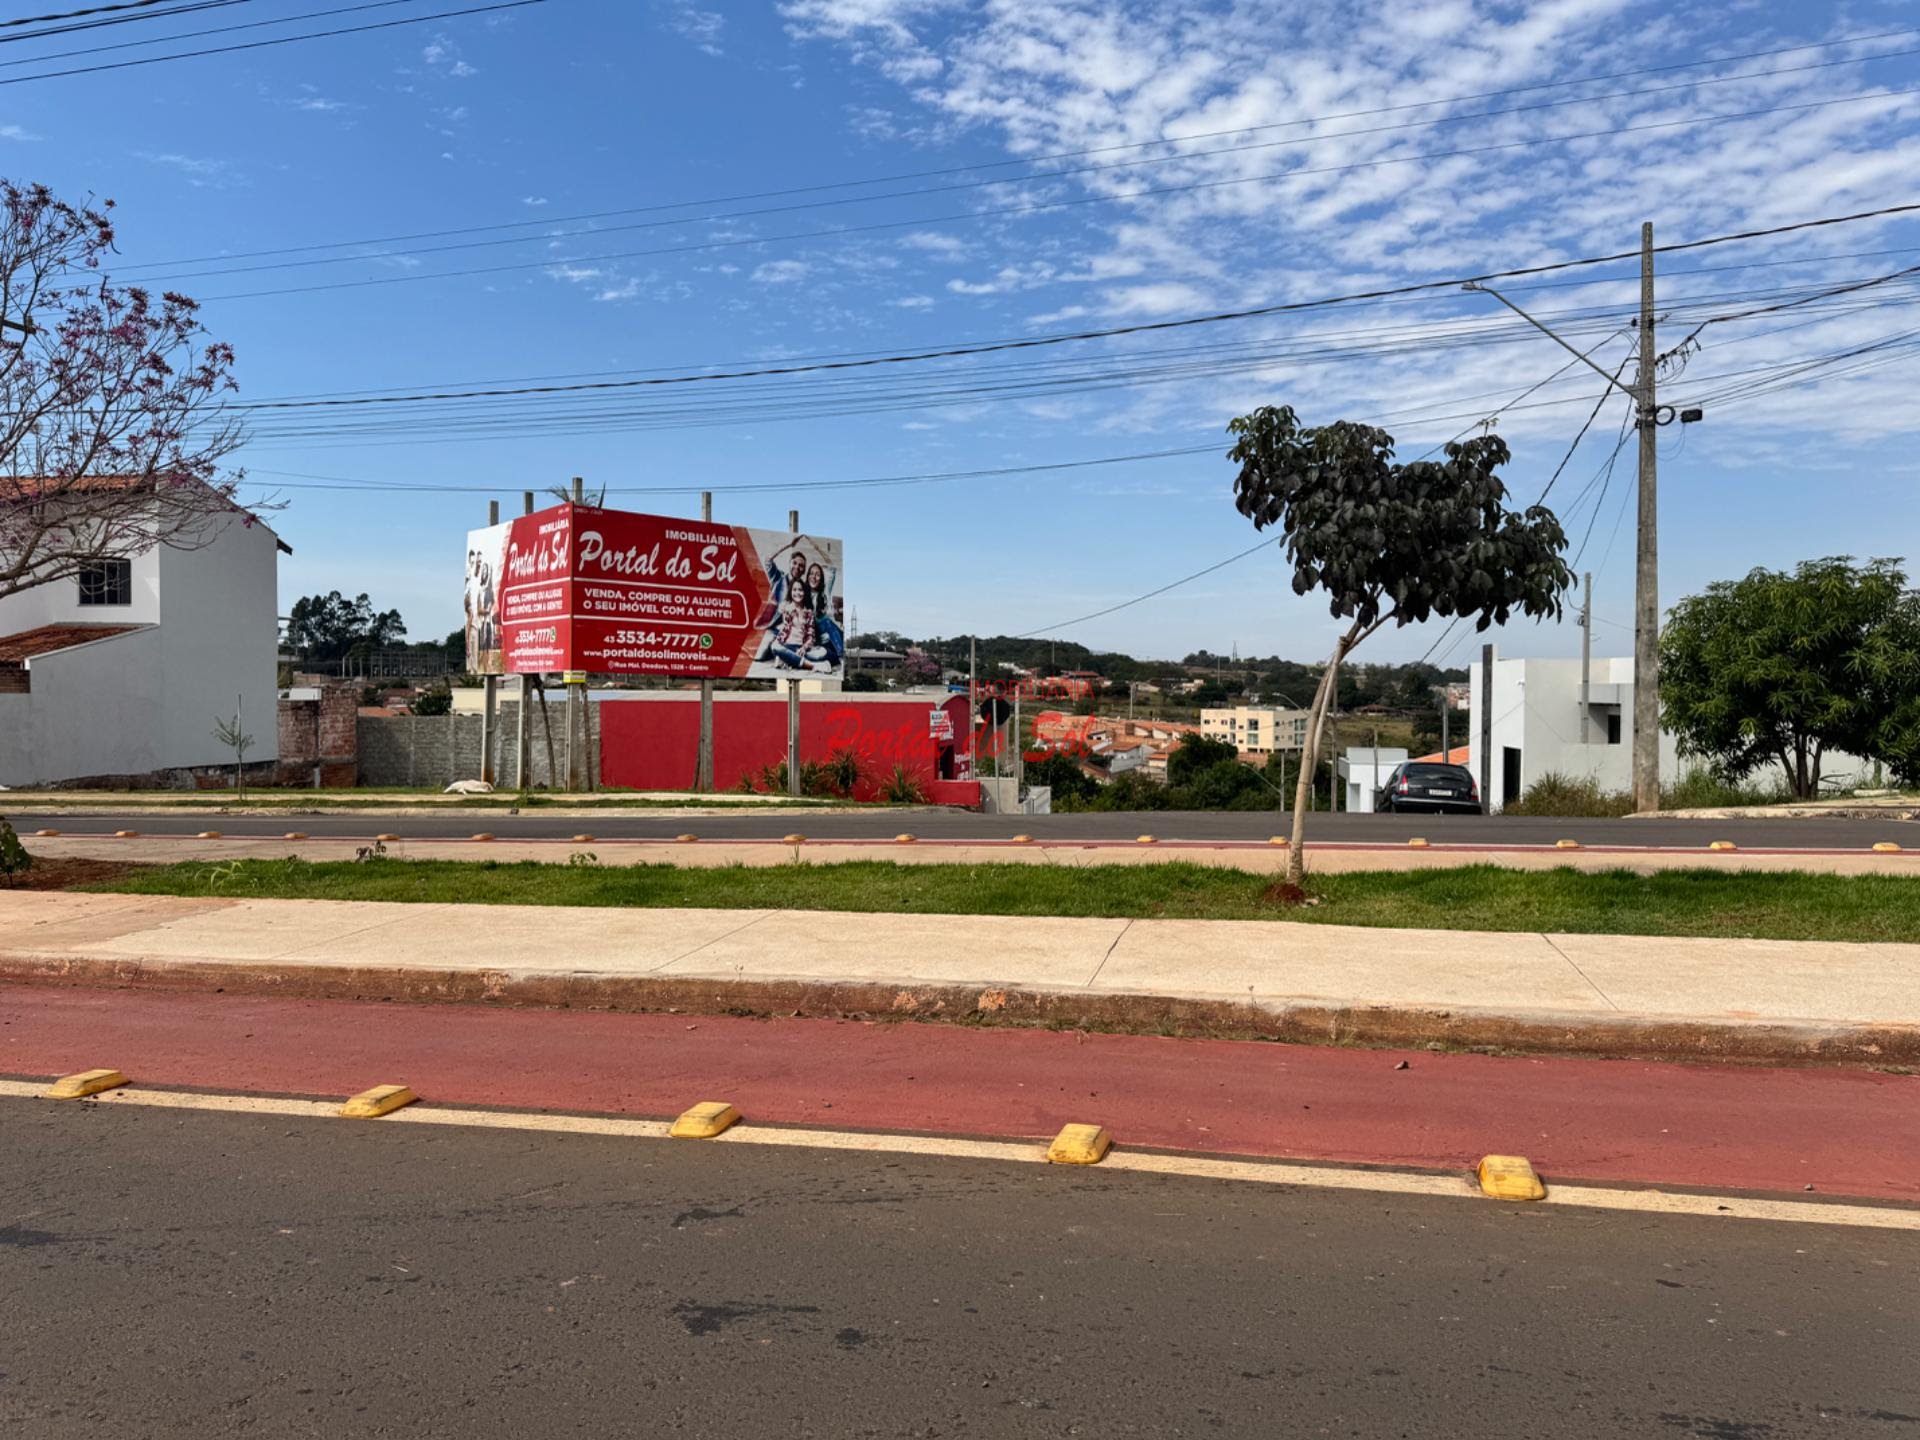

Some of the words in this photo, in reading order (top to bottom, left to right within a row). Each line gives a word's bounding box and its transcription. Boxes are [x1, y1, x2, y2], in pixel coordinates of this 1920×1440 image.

[665, 529, 737, 546] IMOBILIÁRIA
[508, 541, 537, 580] Portal
[538, 540, 549, 572] do
[550, 531, 569, 570] Sol
[578, 530, 661, 575] Portal
[665, 546, 692, 578] do
[697, 545, 738, 583] Sol
[585, 588, 626, 601] VENDA,
[628, 592, 672, 603] COMPRE
[674, 595, 689, 605] OU
[692, 596, 731, 607] ALUGUE
[583, 601, 593, 610] O
[595, 601, 616, 611] SEU
[619, 602, 659, 614] IMÓVEL
[662, 605, 686, 616] COM
[687, 608, 695, 616] A
[697, 608, 733, 620] GENTE!
[603, 635, 615, 644] 43
[616, 630, 699, 647] 3534-7777
[583, 647, 730, 662] www.portaldosolimoveis.com.br
